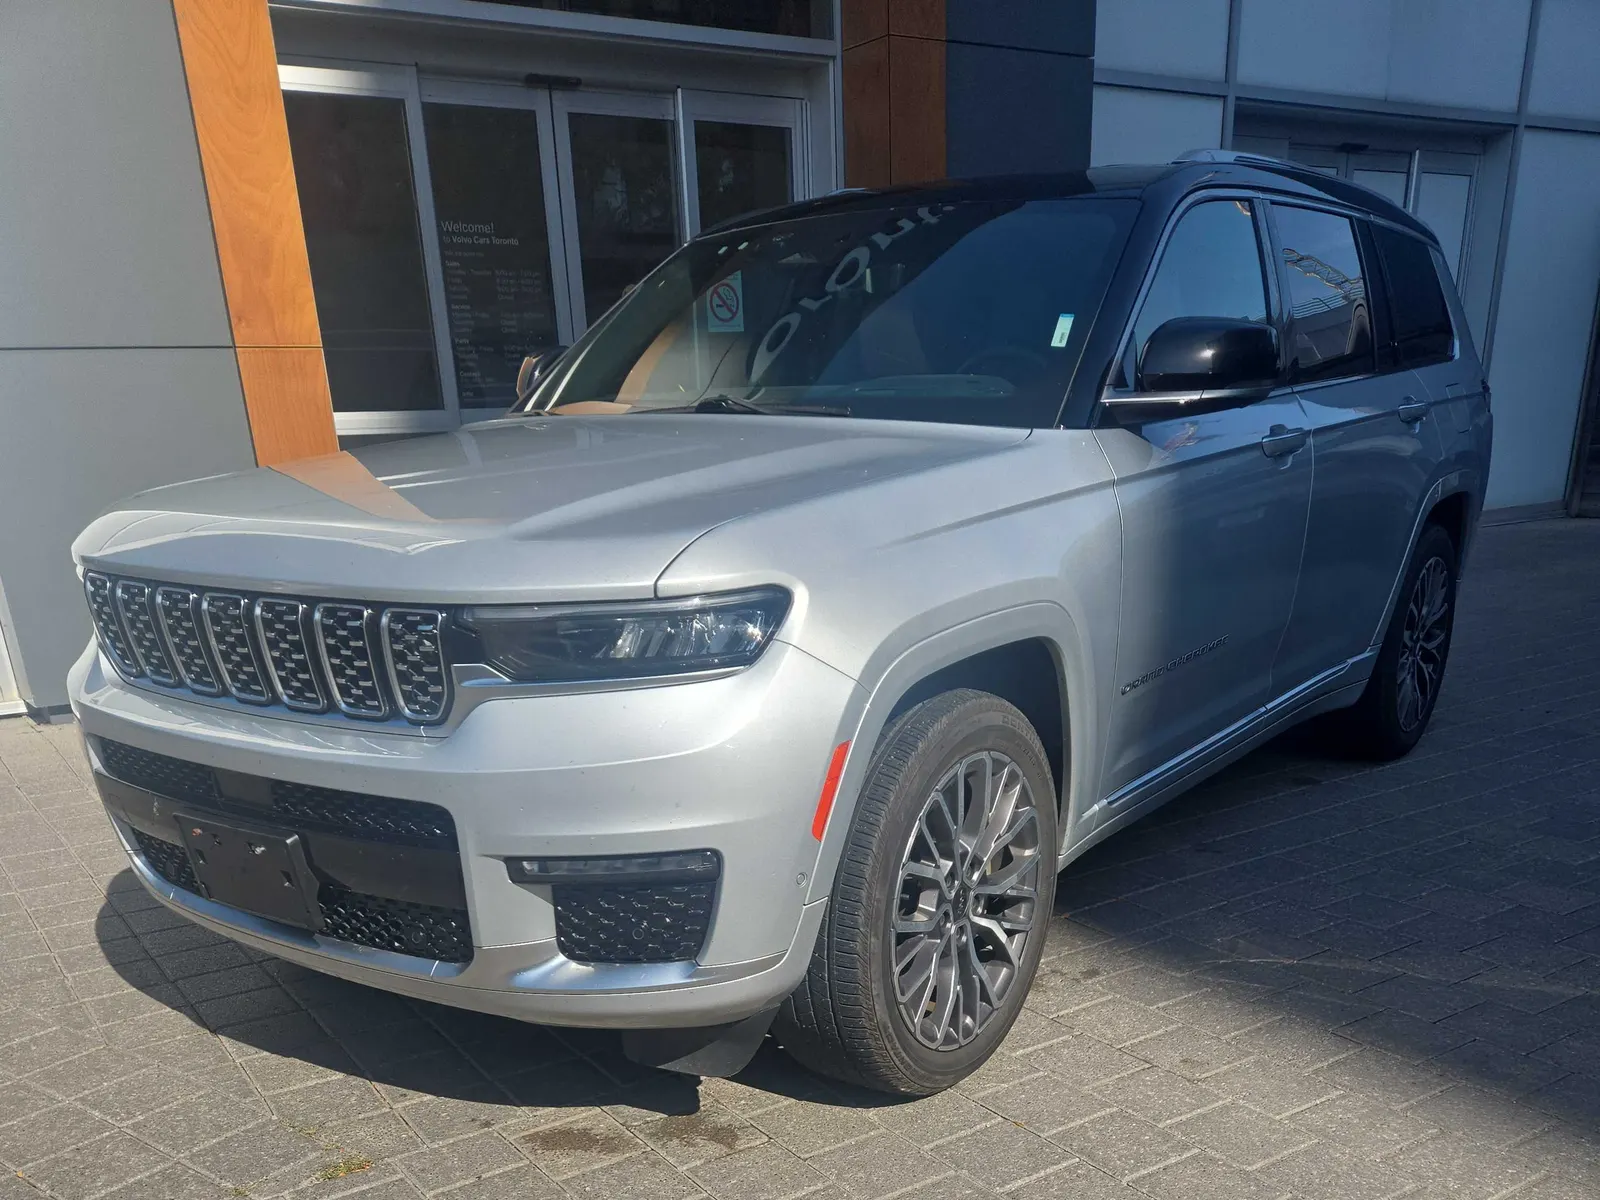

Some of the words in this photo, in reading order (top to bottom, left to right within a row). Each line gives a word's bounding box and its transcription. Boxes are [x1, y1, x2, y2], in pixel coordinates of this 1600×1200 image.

[440, 220, 494, 234] Welcome!
[443, 236, 451, 244] to
[451, 235, 472, 244] Volvo
[473, 236, 490, 244] Cars
[491, 236, 519, 246] Toronto
[1120, 665, 1165, 695] GRAND
[1166, 633, 1229, 671] CHEROKEE
